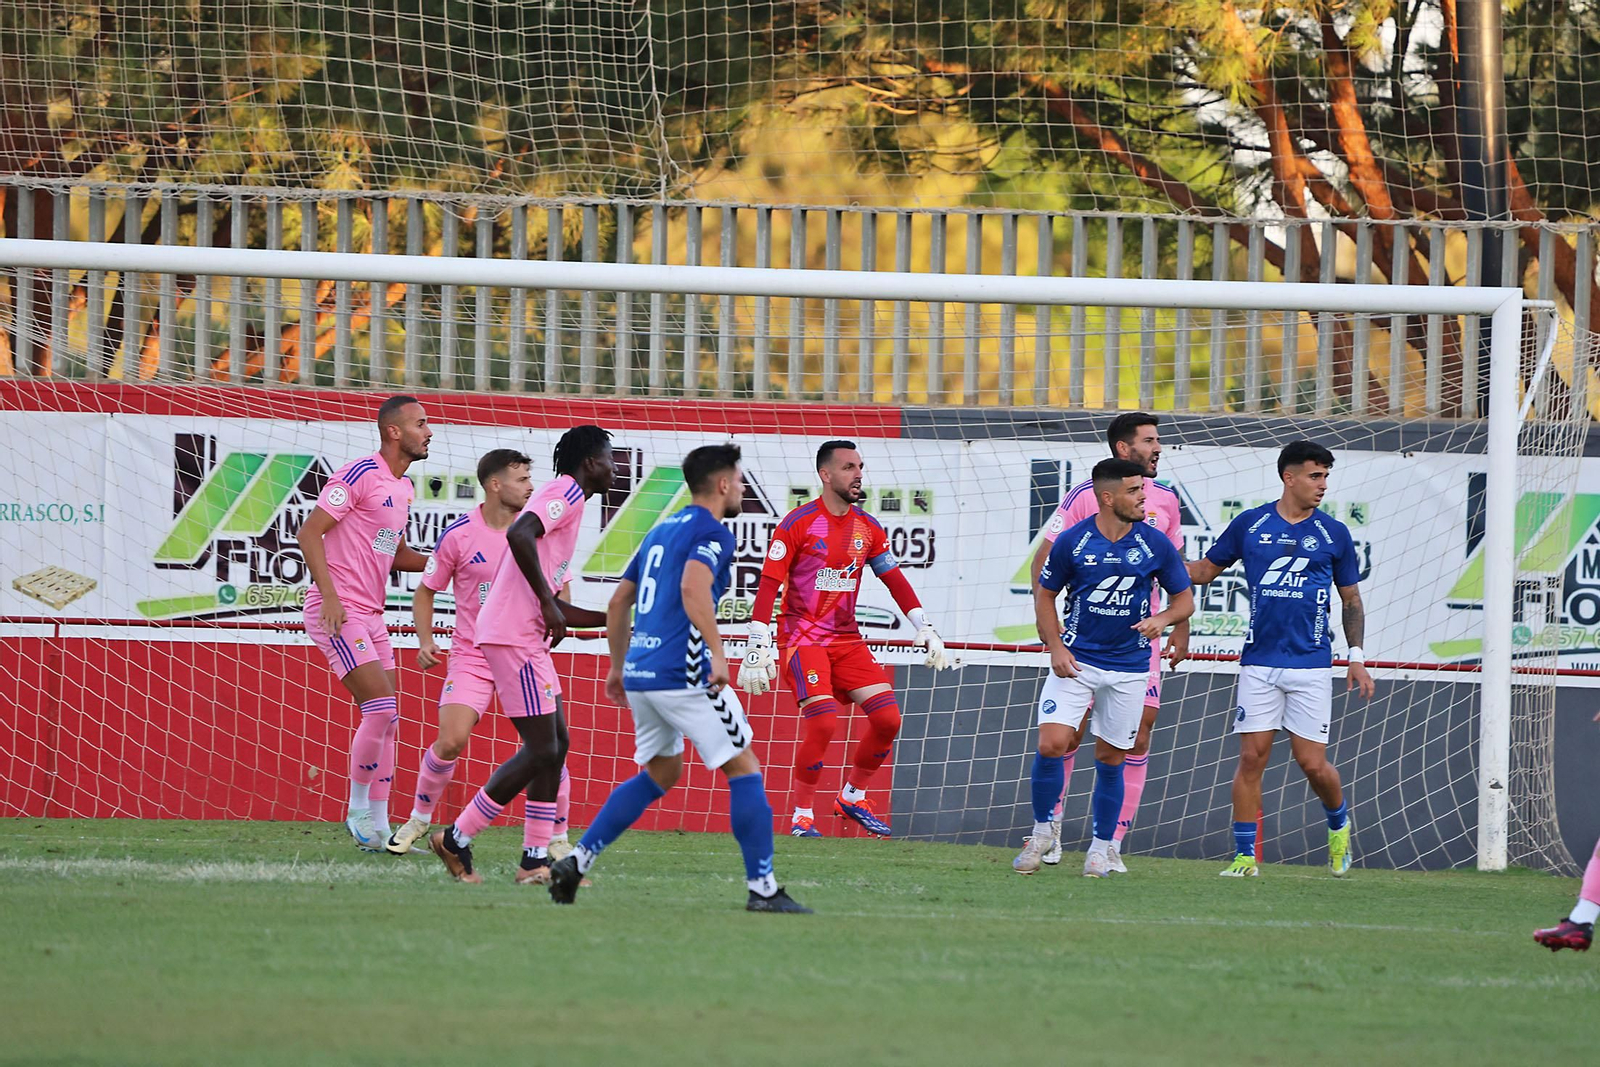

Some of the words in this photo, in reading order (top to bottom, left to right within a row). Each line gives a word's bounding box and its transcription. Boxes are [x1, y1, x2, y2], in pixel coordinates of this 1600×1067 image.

[638, 544, 665, 615] 6
[817, 568, 842, 578] alter
[1279, 571, 1308, 588] Air
[246, 584, 289, 607] 657
[1106, 591, 1135, 606] Air
[1261, 588, 1304, 599] oneair.es
[720, 598, 755, 621] 65
[1088, 605, 1131, 617] oneair.es
